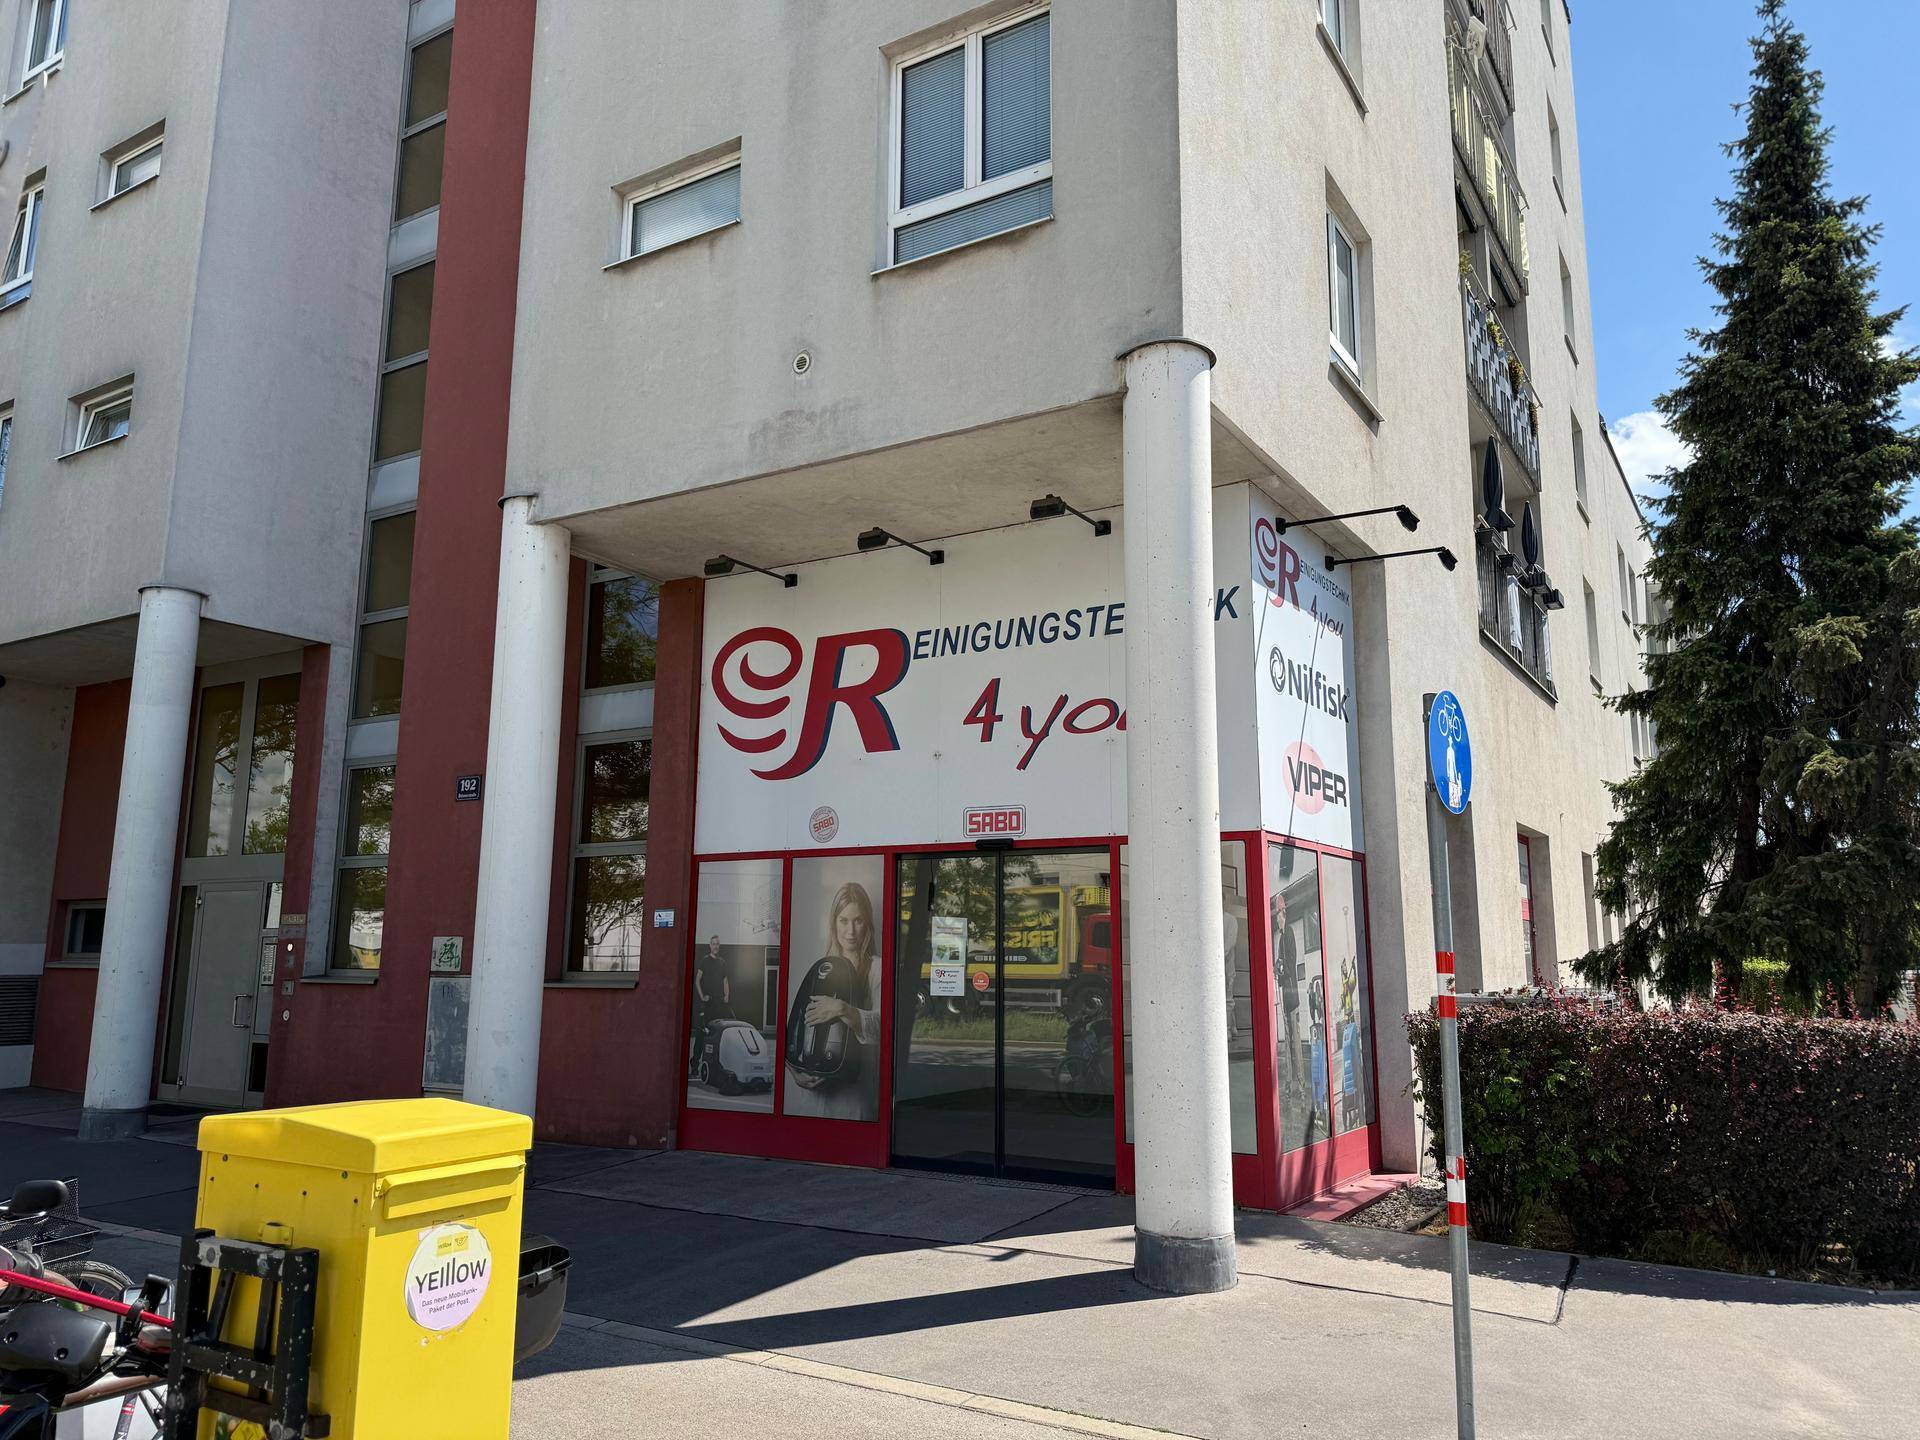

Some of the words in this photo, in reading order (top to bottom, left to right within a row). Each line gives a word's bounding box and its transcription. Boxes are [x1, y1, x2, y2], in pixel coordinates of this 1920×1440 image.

[1307, 594, 1318, 622] 4
[1320, 612, 1344, 639] you
[1288, 658, 1349, 723] Nilfisk
[963, 677, 1004, 743] 4
[1020, 693, 1128, 772] yo
[460, 779, 477, 792] 192
[1287, 756, 1348, 807] VIPER
[813, 816, 835, 832] SABO
[968, 811, 1021, 833] SABO
[421, 1299, 433, 1308] Das
[433, 1295, 448, 1304] neue
[428, 1303, 445, 1314] Paket
[446, 1301, 456, 1310] der
